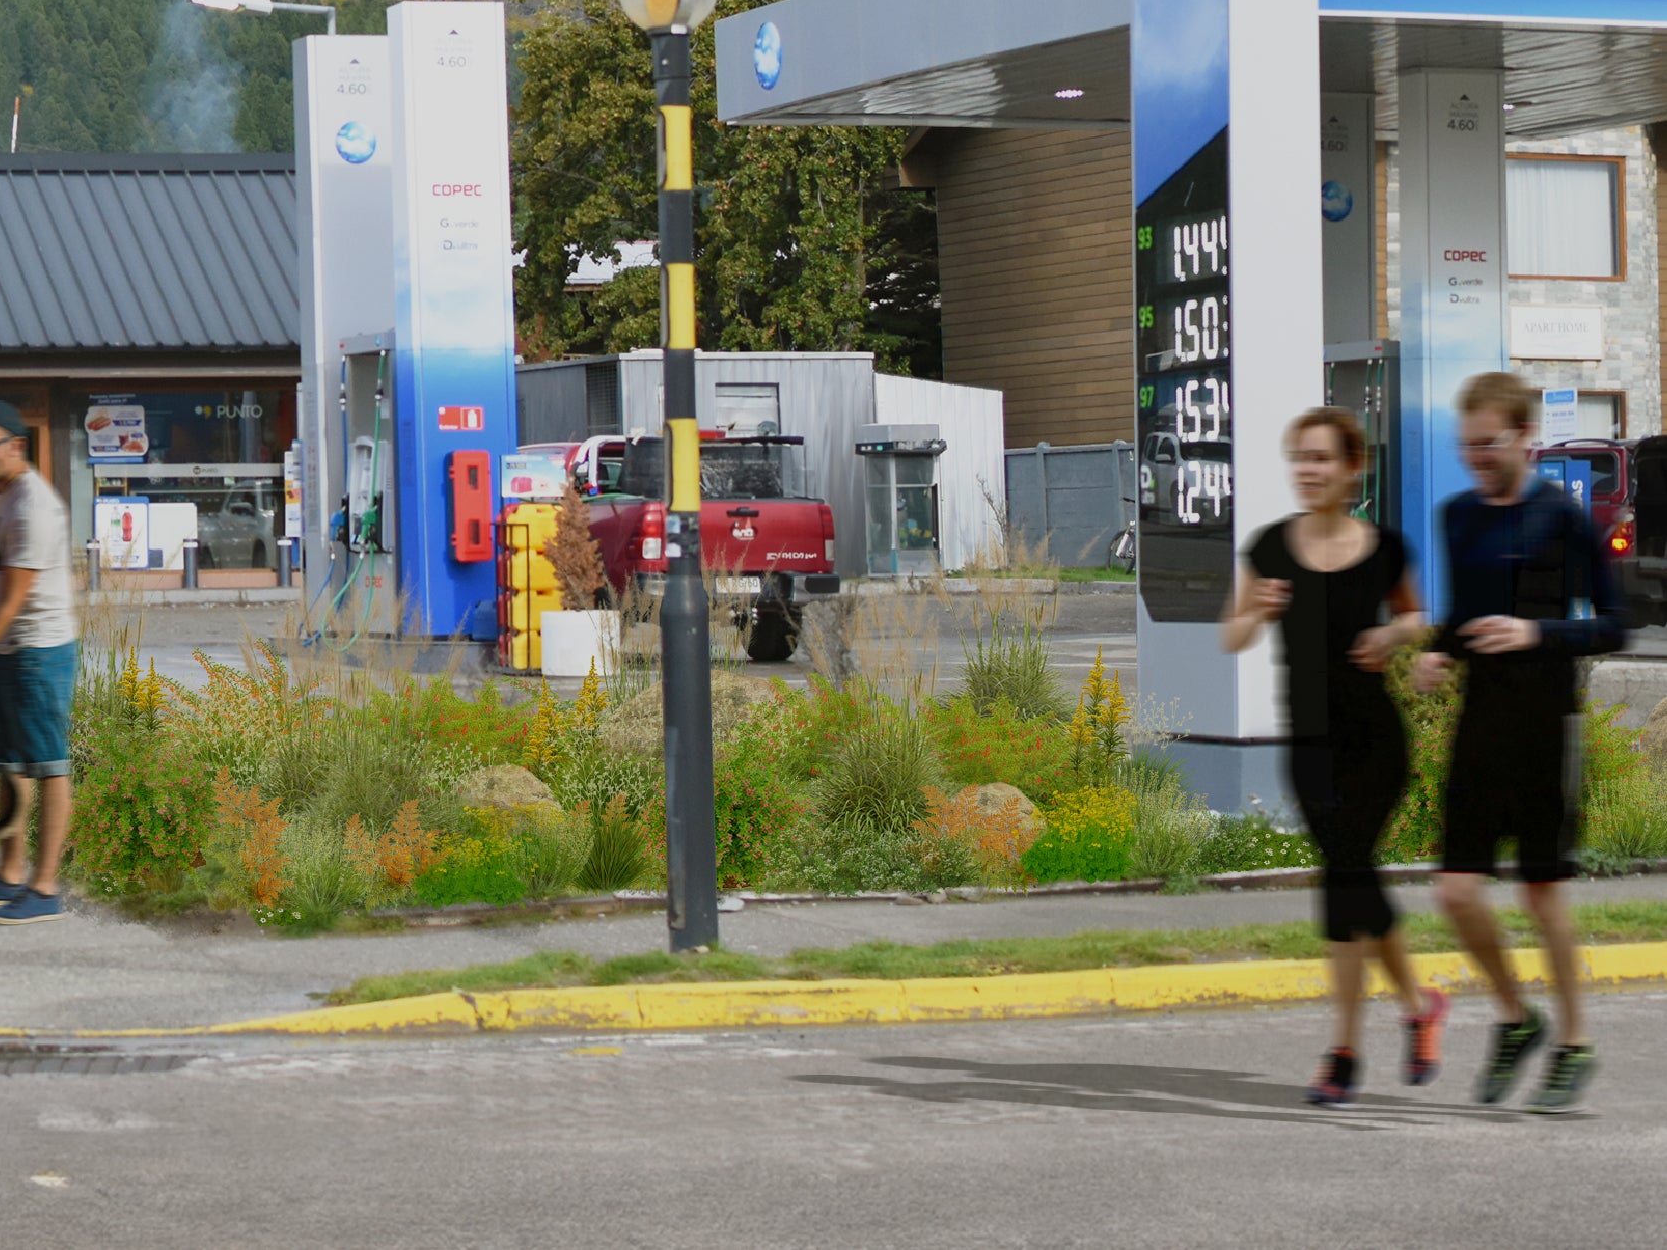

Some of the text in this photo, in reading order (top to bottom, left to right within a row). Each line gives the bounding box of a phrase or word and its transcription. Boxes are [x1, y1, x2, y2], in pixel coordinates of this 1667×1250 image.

[1447, 119, 1475, 131] 4.60
[1138, 226, 1153, 250] 93
[1138, 305, 1154, 329] 95
[1139, 385, 1155, 409] 97
[217, 404, 263, 419] PUNTO
